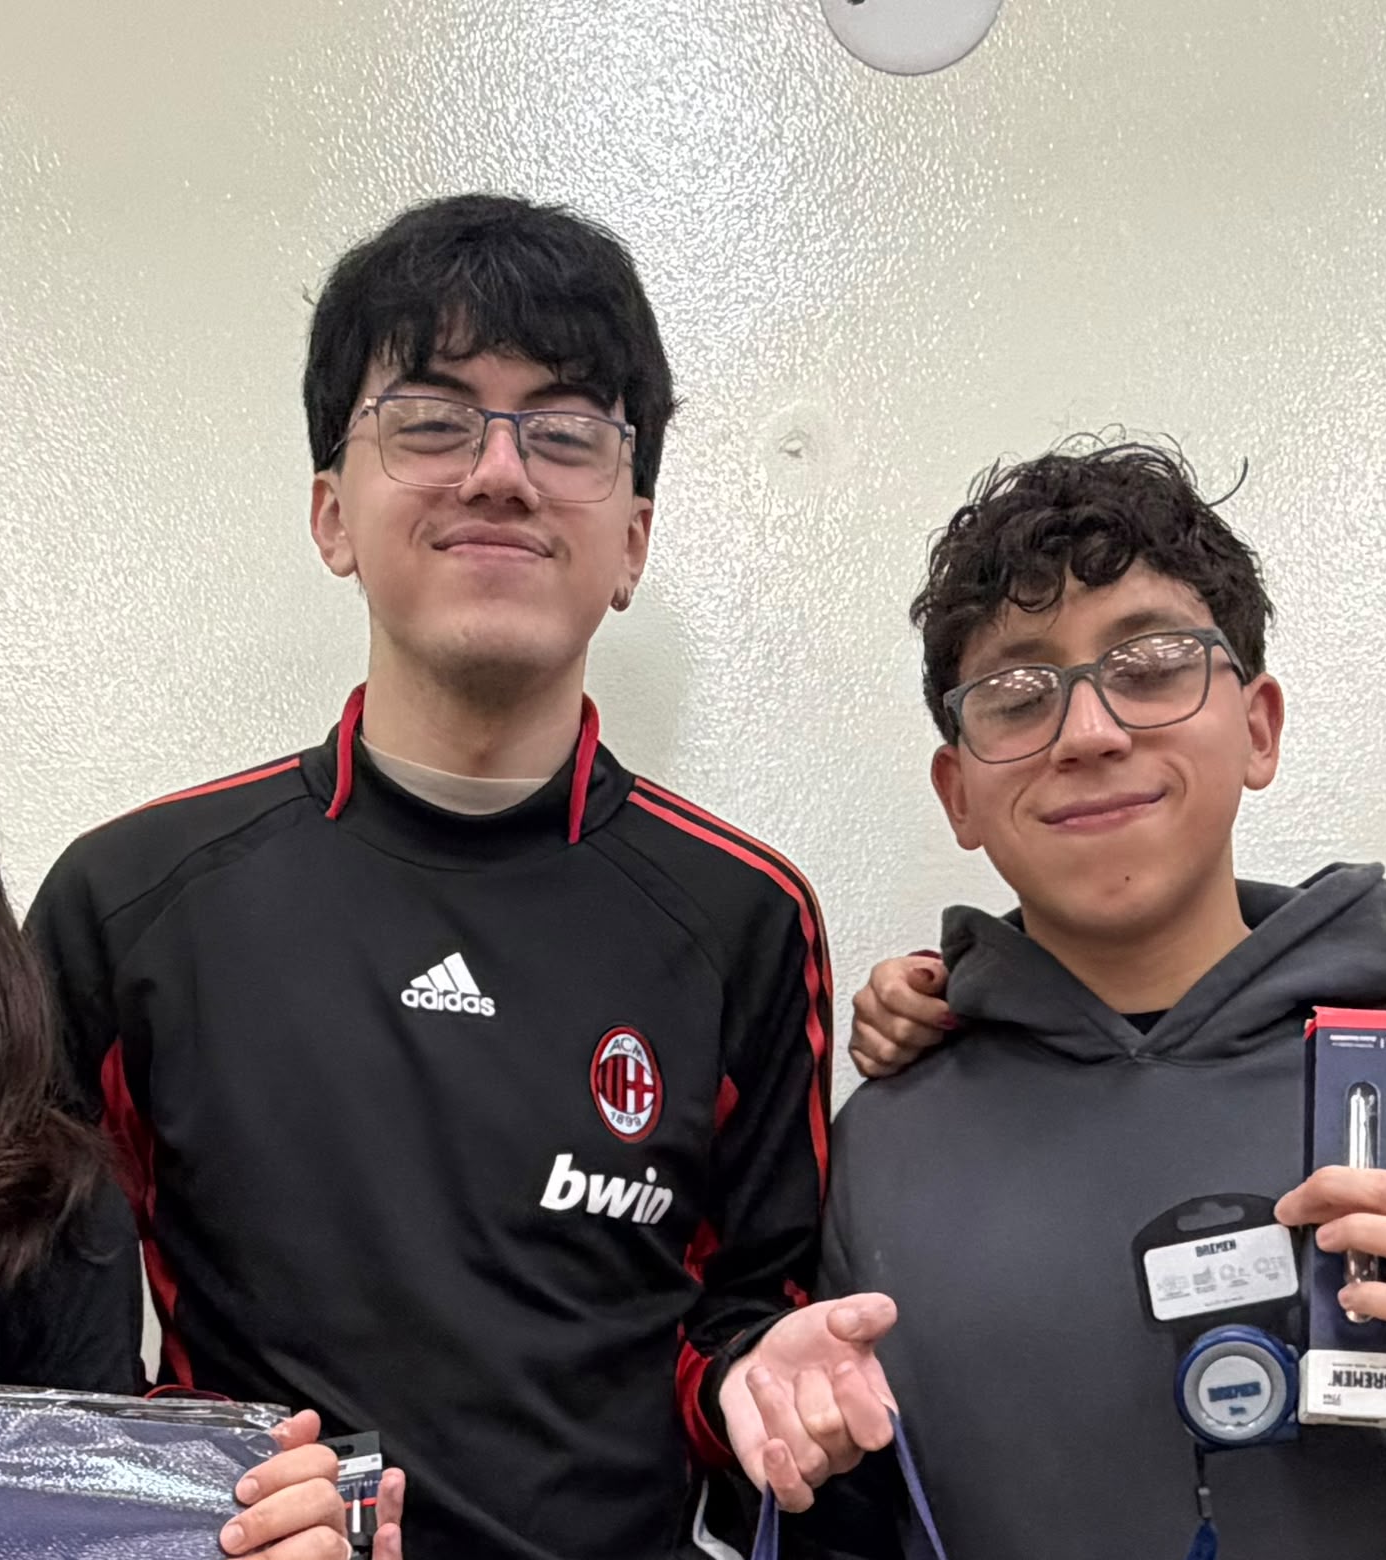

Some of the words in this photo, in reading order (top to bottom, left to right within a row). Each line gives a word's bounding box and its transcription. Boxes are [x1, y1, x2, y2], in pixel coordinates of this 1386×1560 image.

[401, 987, 496, 1017] adidas
[608, 1036, 645, 1062] ACM
[610, 1110, 643, 1128] 1899
[540, 1153, 674, 1225] bwin
